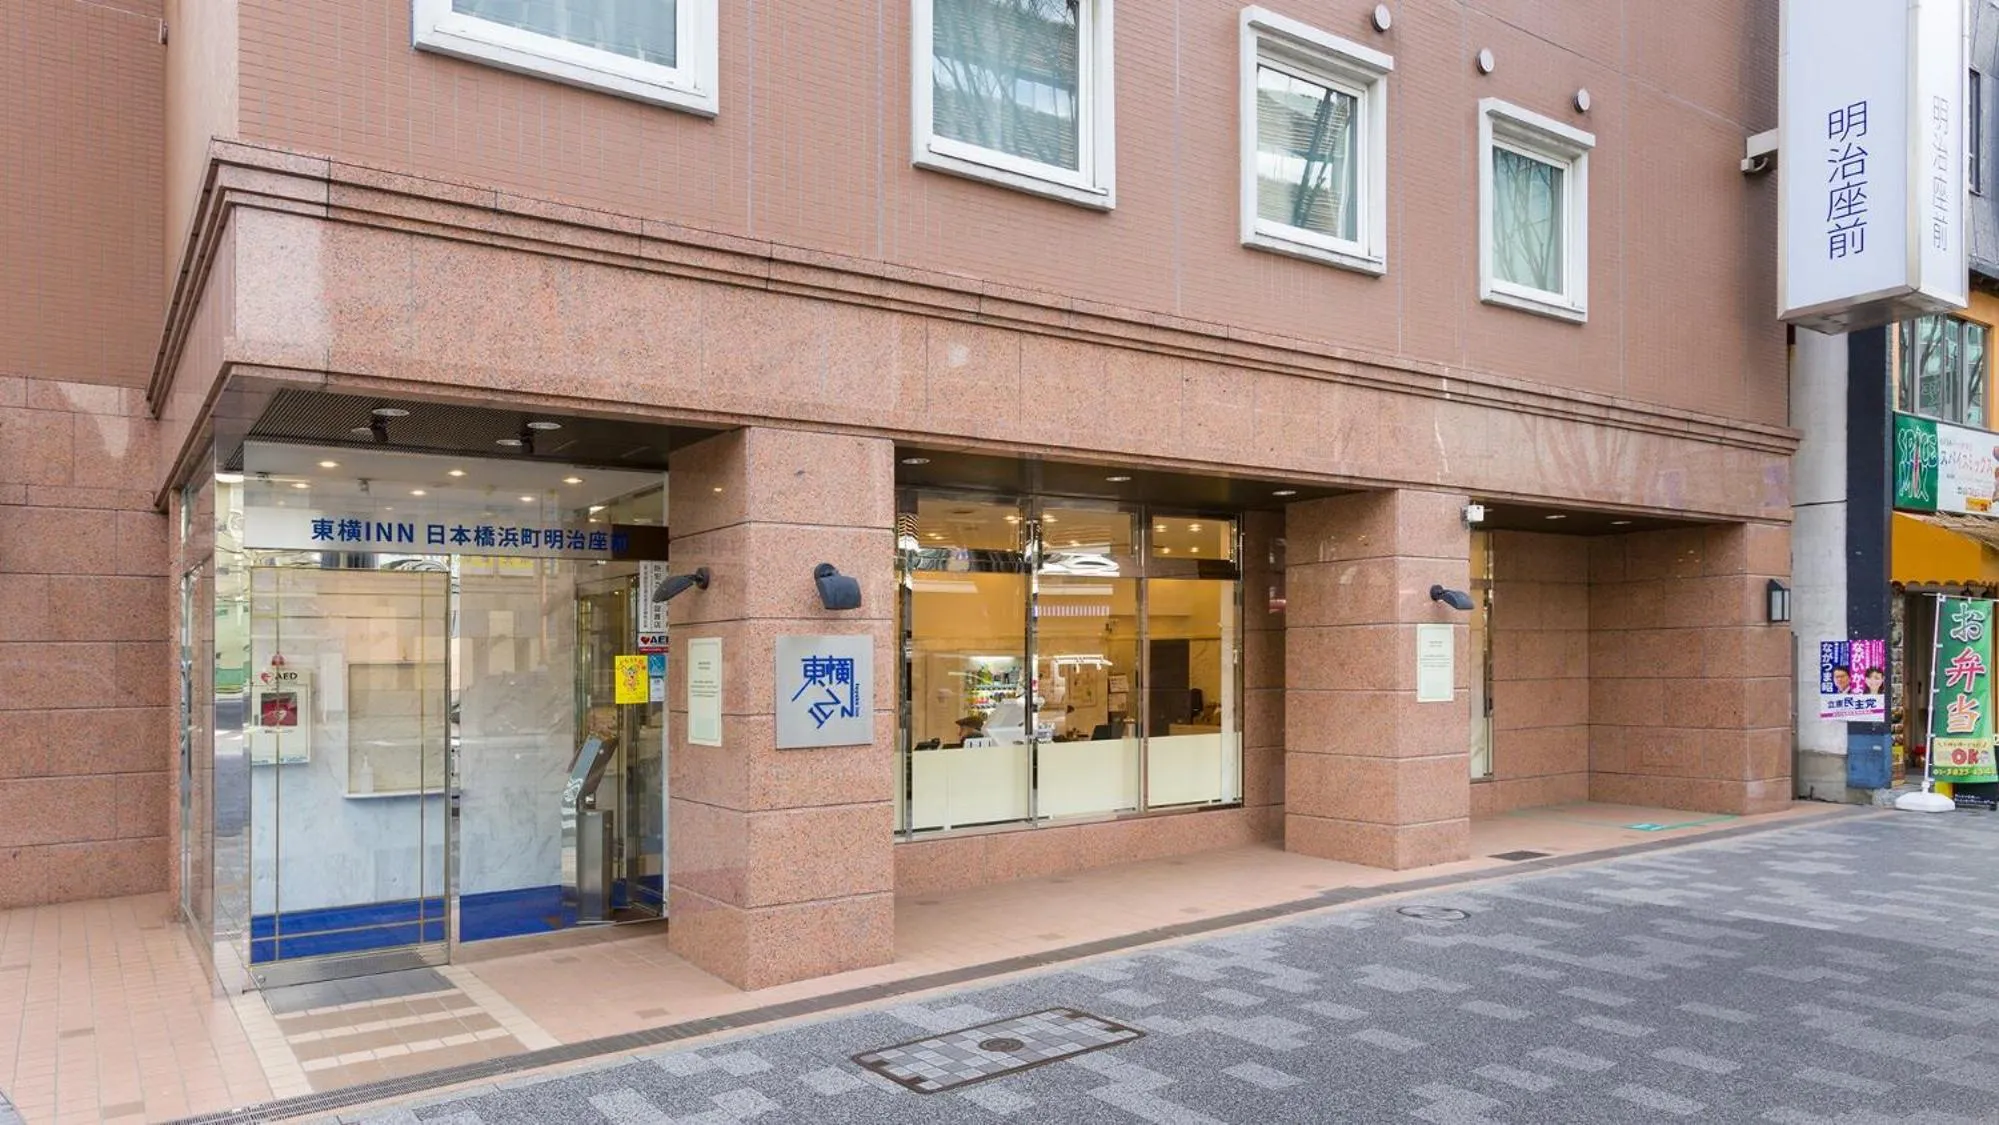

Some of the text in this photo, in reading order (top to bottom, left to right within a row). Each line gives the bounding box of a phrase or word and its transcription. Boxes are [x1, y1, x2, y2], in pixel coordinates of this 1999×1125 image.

[1827, 101, 1868, 260] 明治座前
[311, 518, 630, 552] 東横INN 日本橋浜町明治座前
[275, 672, 298, 680] AED
[1946, 604, 1985, 732] お弁当
[1951, 748, 1979, 766] OK
